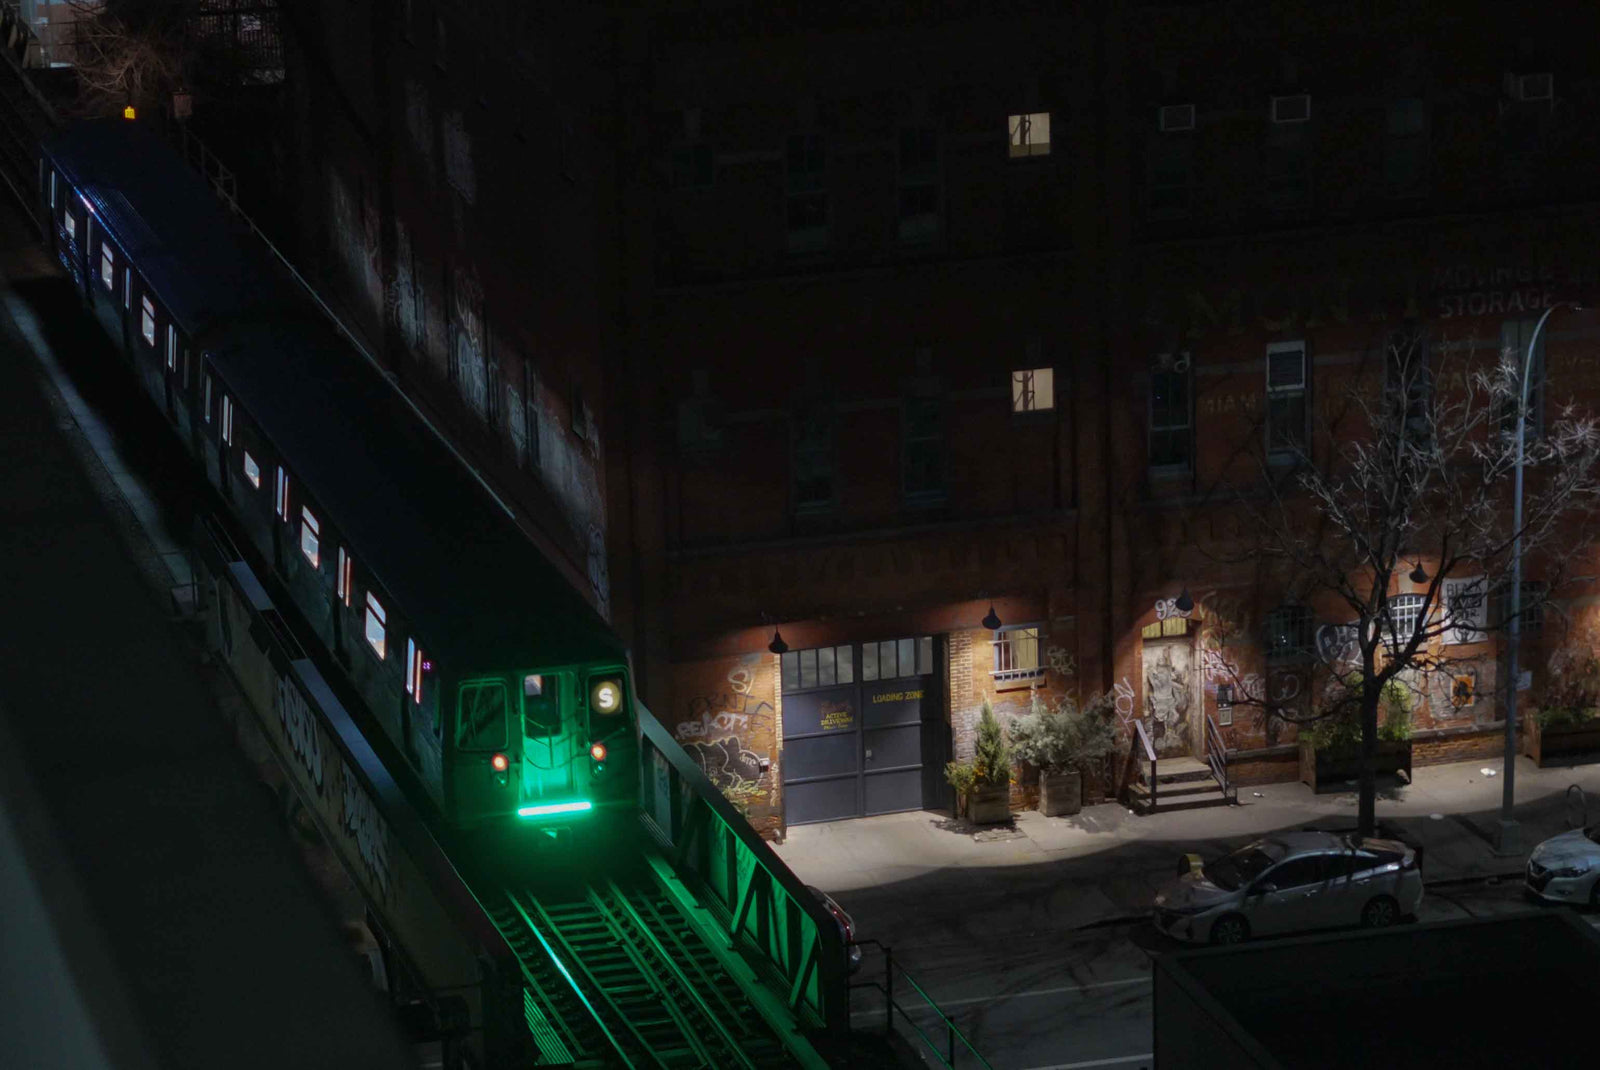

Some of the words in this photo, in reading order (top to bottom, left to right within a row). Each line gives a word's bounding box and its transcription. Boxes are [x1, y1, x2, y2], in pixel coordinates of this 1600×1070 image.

[1439, 289, 1551, 318] STORAGE
[599, 687, 614, 708] S
[872, 692, 903, 704] LOADING
[904, 689, 924, 700] ZONE
